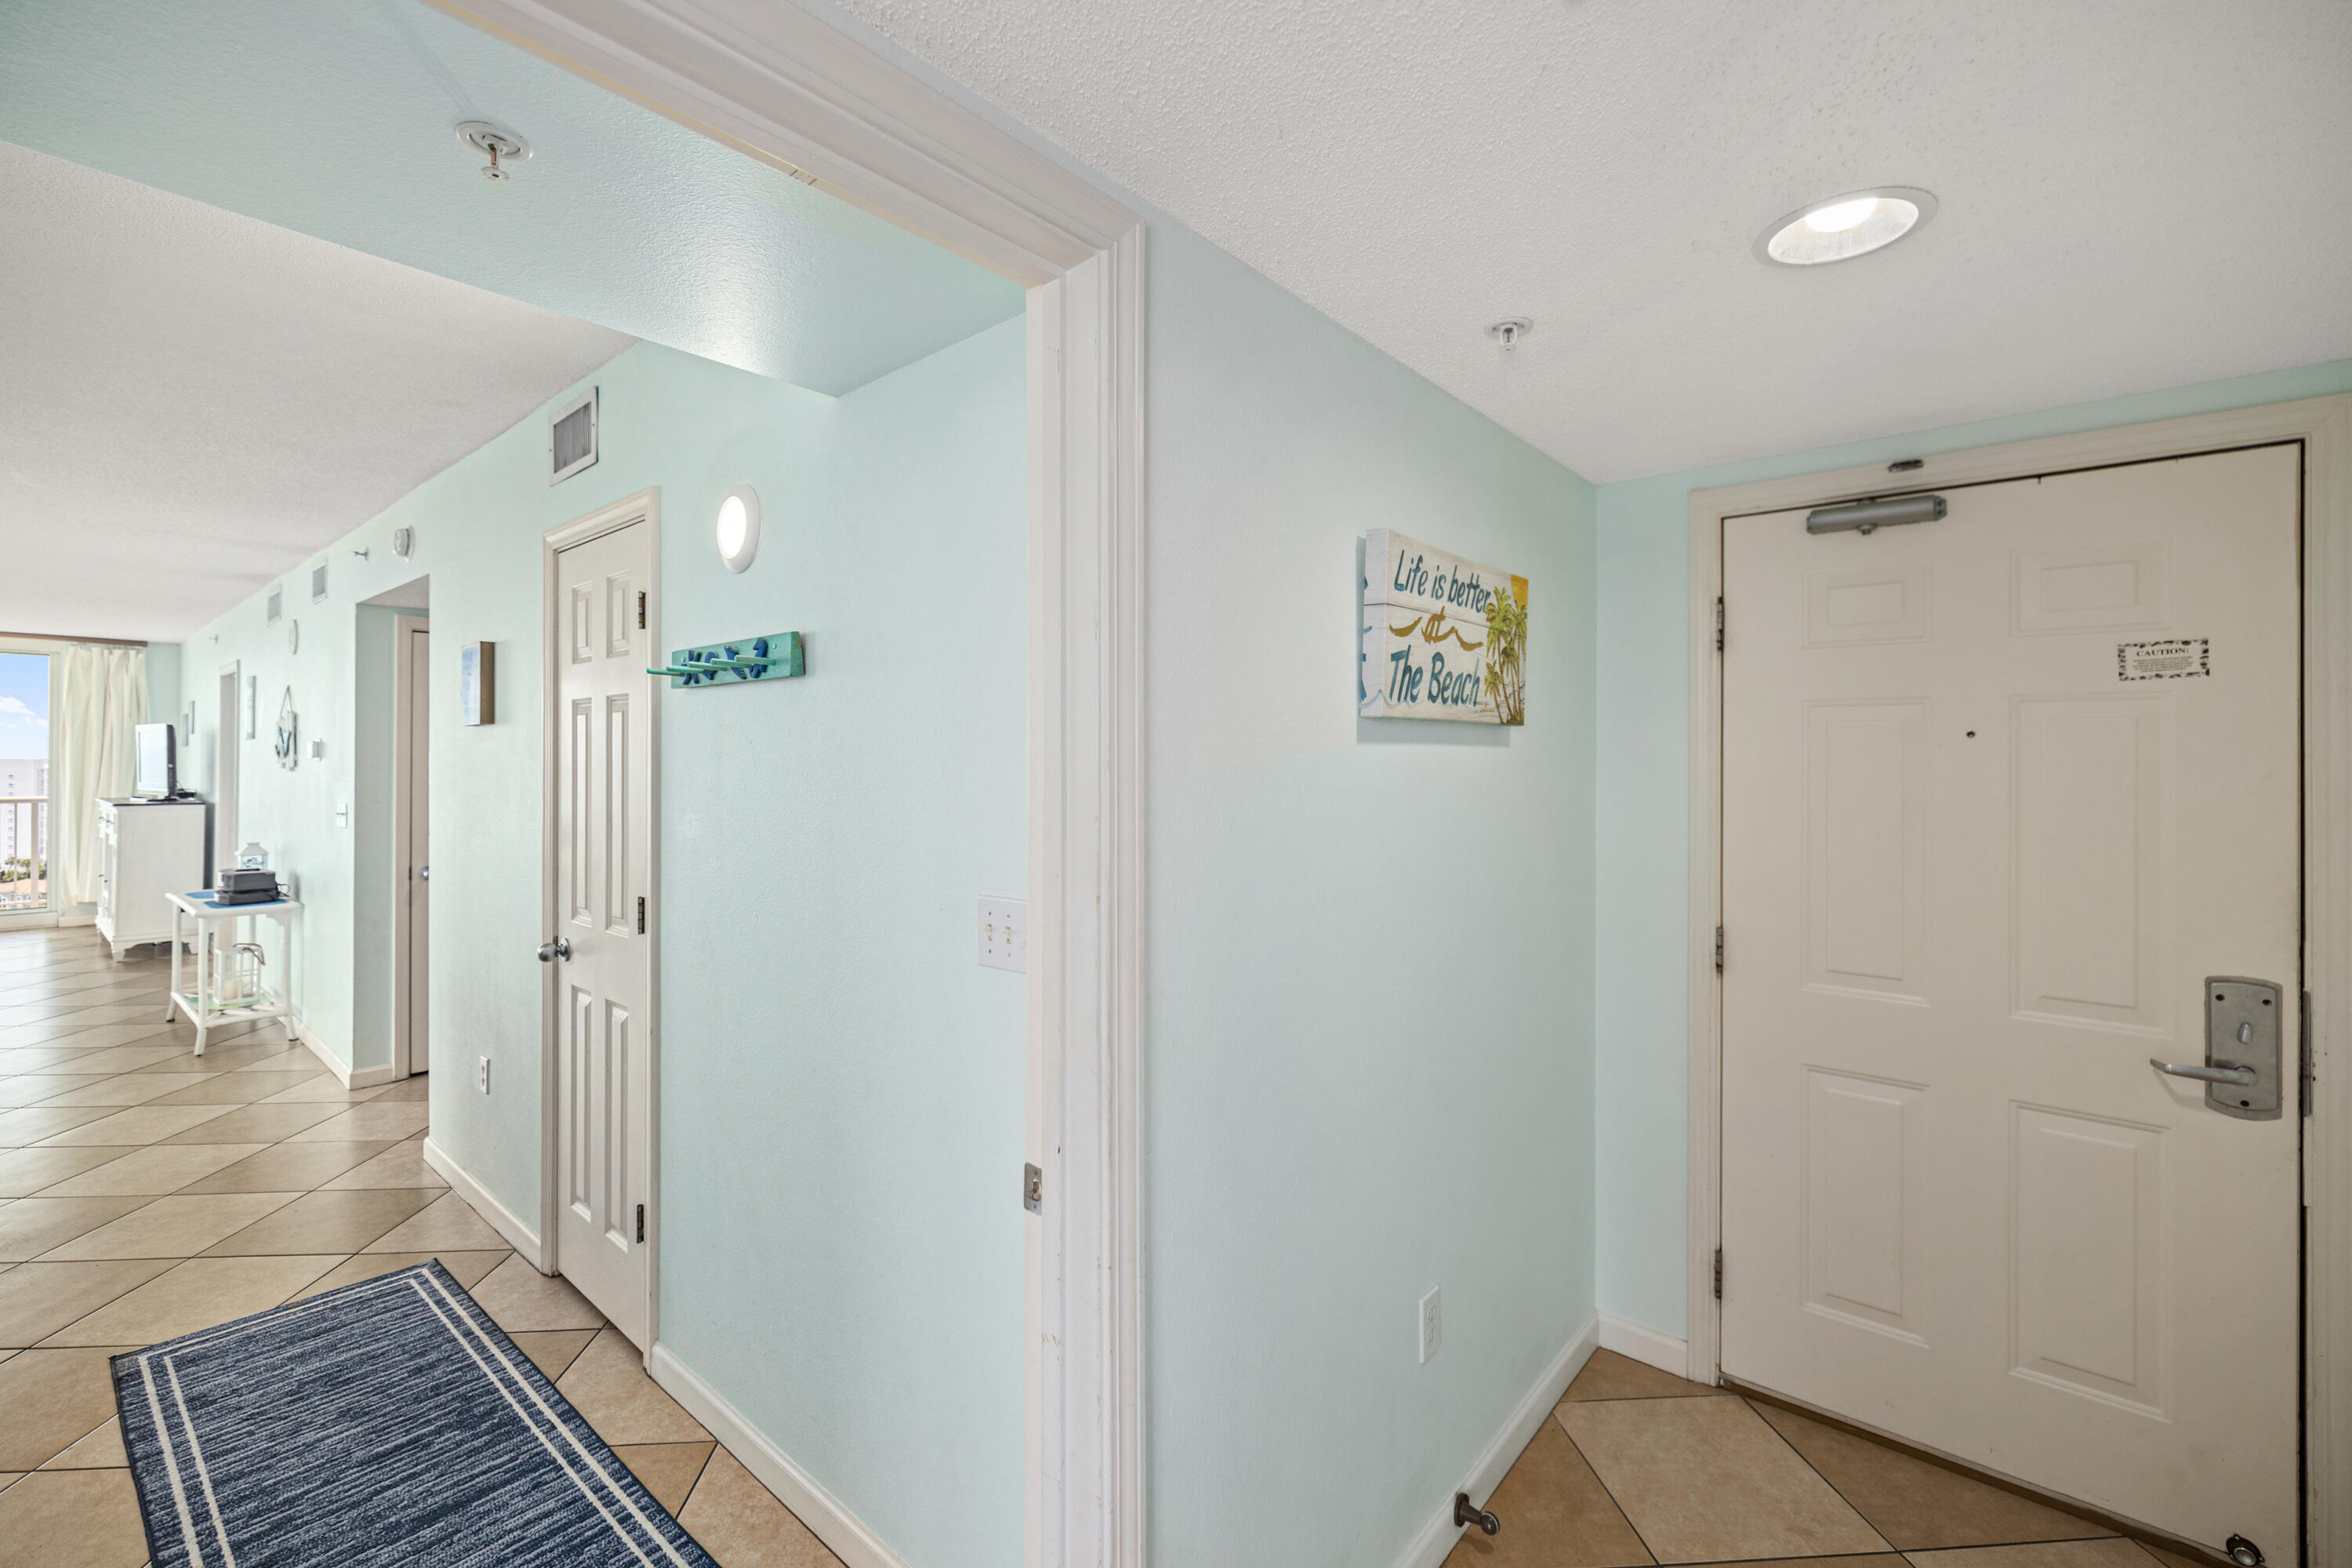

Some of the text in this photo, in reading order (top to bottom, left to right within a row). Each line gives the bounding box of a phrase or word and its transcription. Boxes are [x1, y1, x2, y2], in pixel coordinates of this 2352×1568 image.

[1394, 550, 1491, 613] Life is better
[1389, 644, 1481, 707] The Beach
